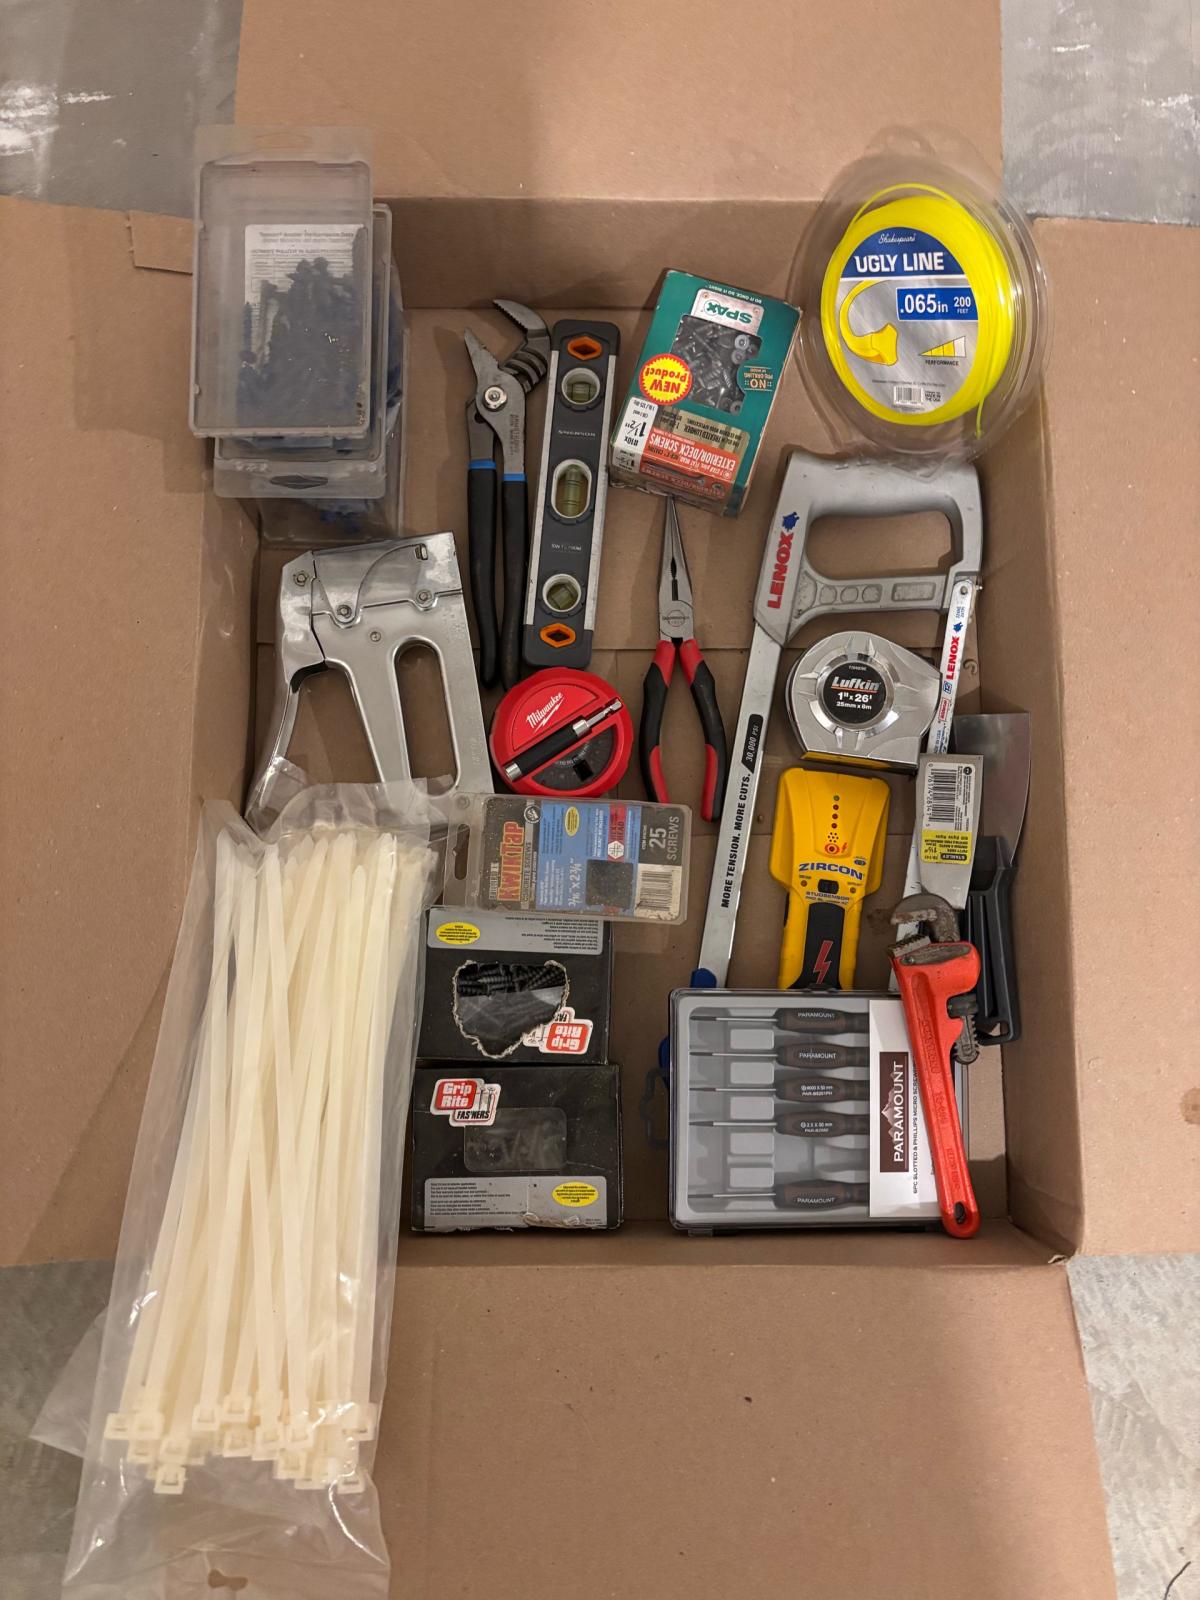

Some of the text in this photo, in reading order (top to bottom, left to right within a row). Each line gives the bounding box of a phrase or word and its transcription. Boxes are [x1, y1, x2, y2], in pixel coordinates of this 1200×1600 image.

[854, 252, 944, 272] UGLY LINE
[705, 302, 753, 324] SPAX
[900, 294, 971, 313] .065in 200
[644, 364, 687, 383] Product
[651, 378, 680, 394] NEW
[750, 379, 766, 389] NO
[649, 433, 679, 452] SCREWS
[680, 443, 736, 471] EXTERIOR/DECK
[768, 532, 794, 609] LENOX
[946, 636, 959, 680] LENOX
[832, 677, 880, 690] Lufkin
[838, 692, 848, 700] 1"
[855, 694, 872, 702] 26'
[526, 692, 564, 728] Milwaukee
[616, 821, 625, 840] HEAD
[648, 827, 667, 849] 25
[666, 816, 680, 860] SCREWS
[721, 773, 751, 908] MORE TENSION. MORE CUTS.
[523, 842, 532, 868] SCREWS
[799, 863, 863, 881] ZIRCON
[555, 1026, 582, 1038] Rite
[552, 1036, 580, 1050] Grip
[442, 1083, 472, 1096] Grip
[441, 1096, 469, 1107] Rite
[893, 1061, 904, 1162] PARAMOUNT
